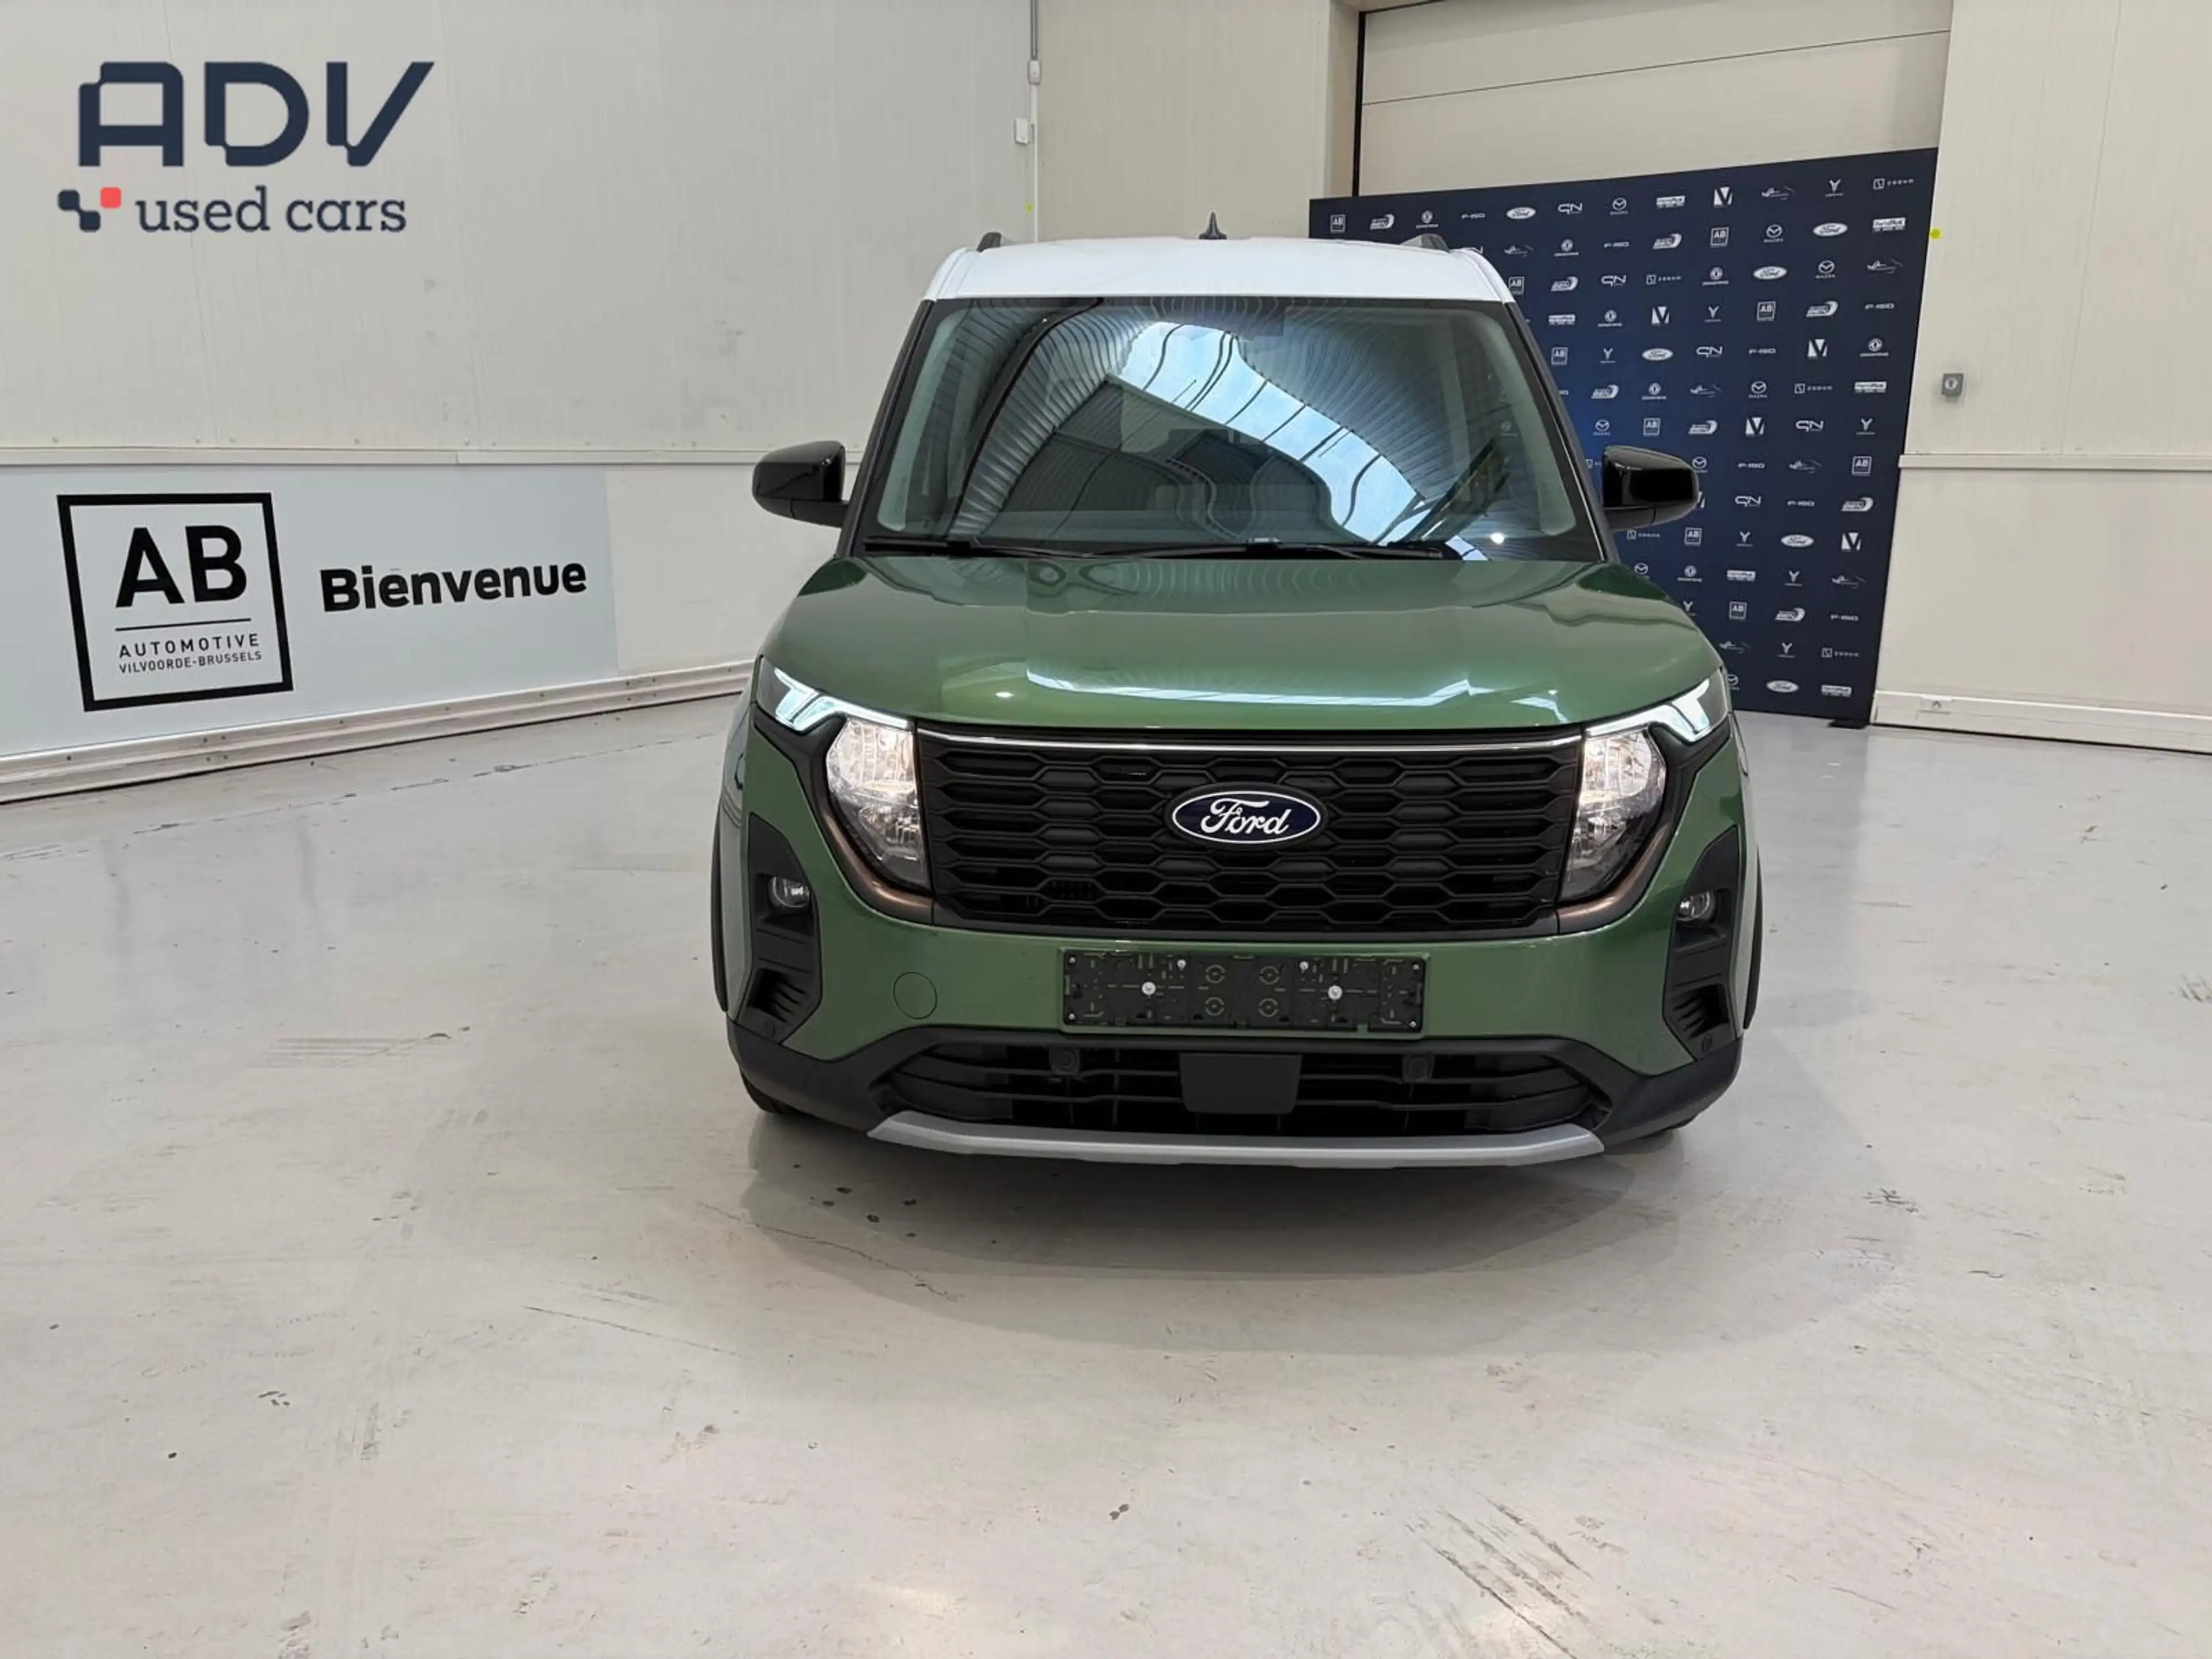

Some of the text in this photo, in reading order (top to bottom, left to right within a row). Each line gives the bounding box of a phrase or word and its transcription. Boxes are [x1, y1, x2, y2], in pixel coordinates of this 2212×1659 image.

[116, 525, 246, 607] AB
[321, 563, 586, 611] Bienvenue
[119, 633, 260, 658] AUTOMOTIVE
[119, 651, 262, 674] VILVOORDE-BRUSSELS
[1200, 798, 1292, 834] Ford
